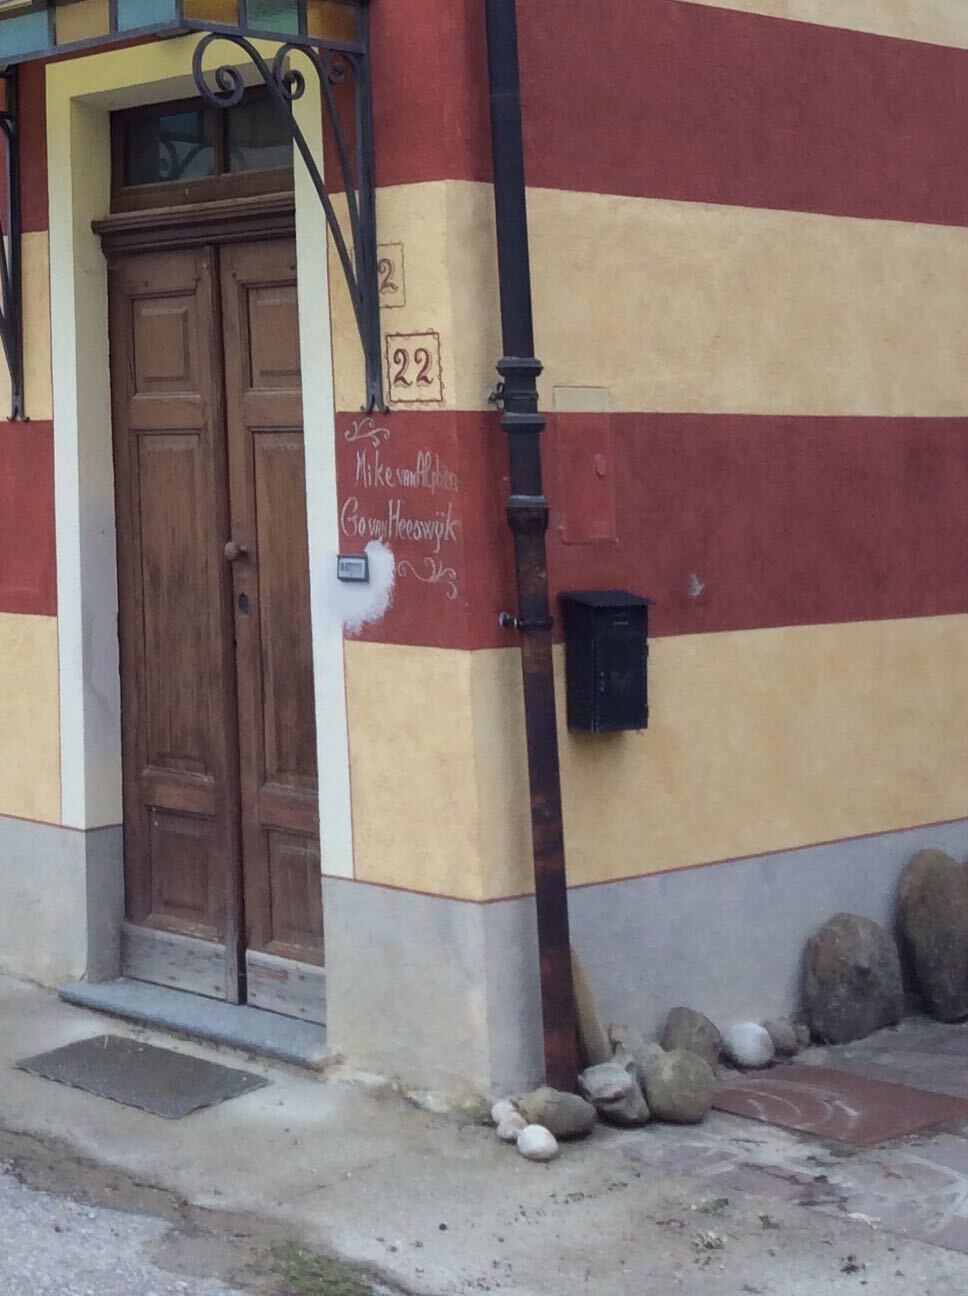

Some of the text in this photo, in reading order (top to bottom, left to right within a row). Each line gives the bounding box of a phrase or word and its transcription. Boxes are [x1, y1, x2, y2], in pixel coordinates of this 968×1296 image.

[377, 257, 399, 295] 2
[392, 347, 434, 386] 22
[355, 449, 395, 489] Mike
[340, 496, 366, 537] Go
